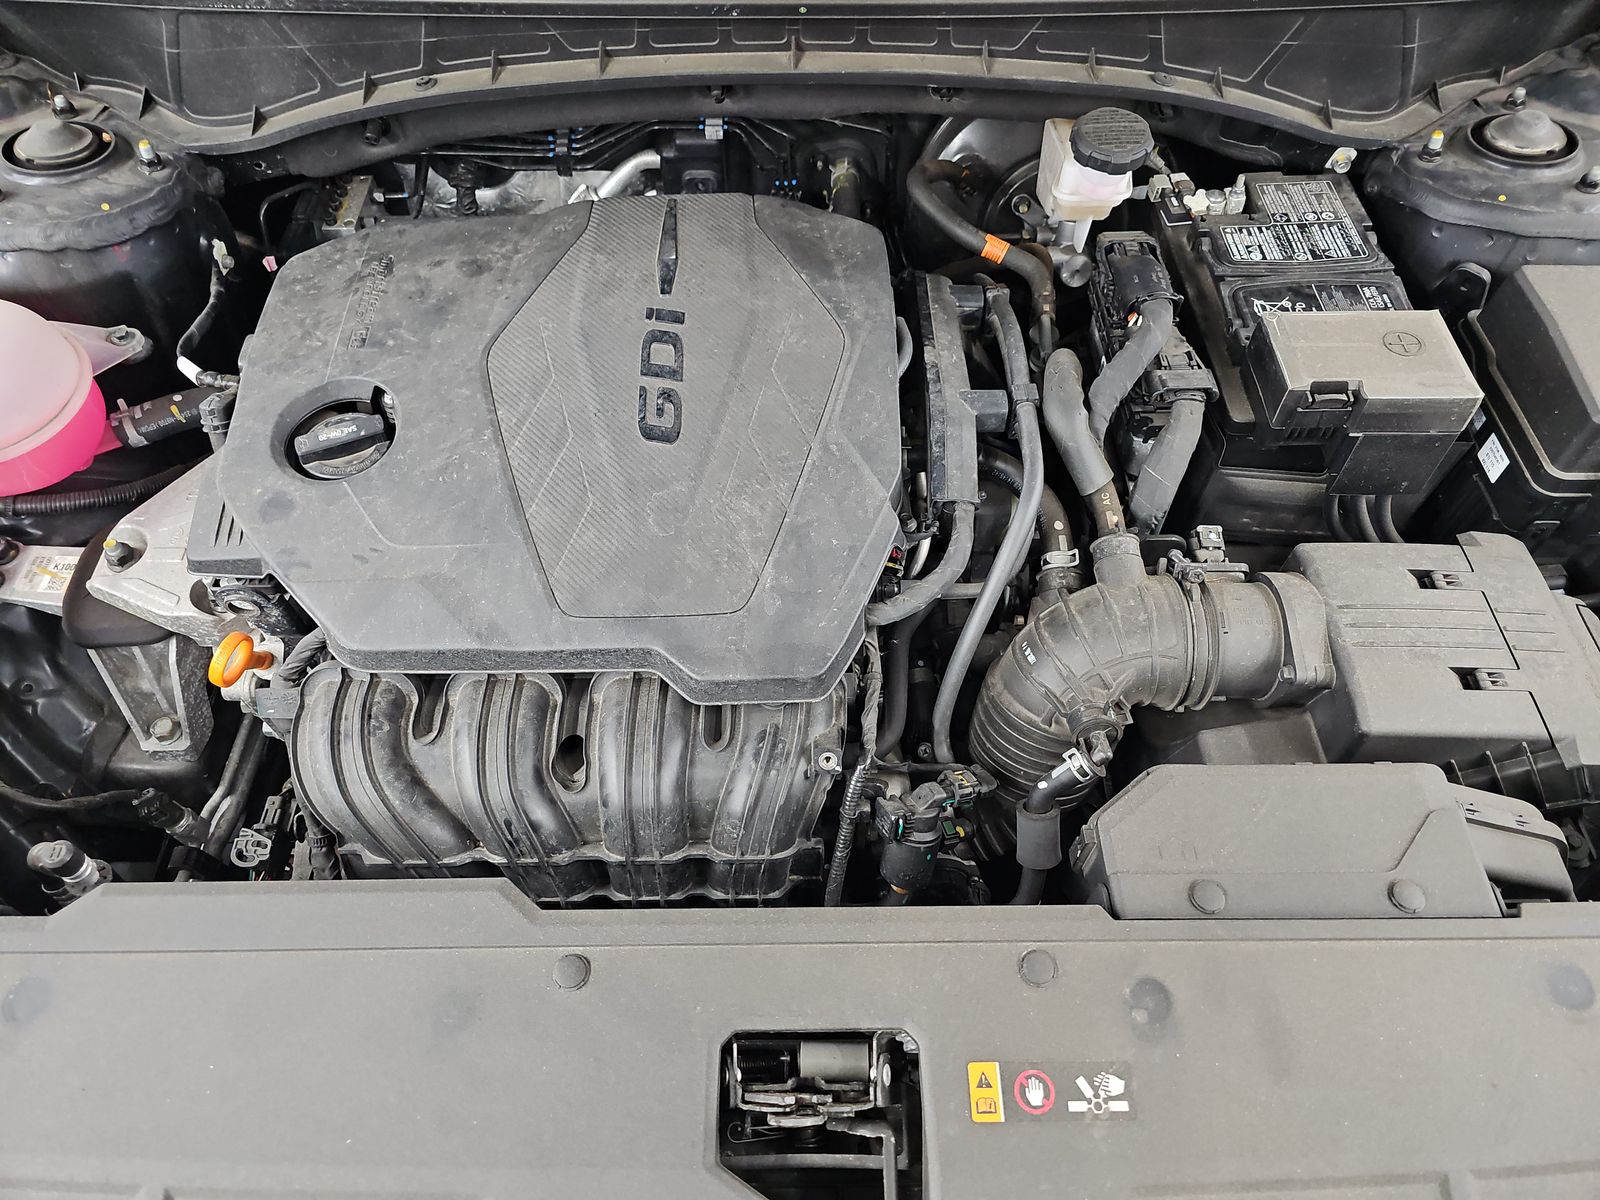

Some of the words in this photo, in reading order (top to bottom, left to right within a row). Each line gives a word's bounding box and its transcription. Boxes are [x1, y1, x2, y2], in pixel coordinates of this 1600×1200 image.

[638, 307, 686, 445] GDi
[342, 424, 358, 434] SAE
[318, 430, 342, 442] 0W-20
[1101, 492, 1112, 505] AC
